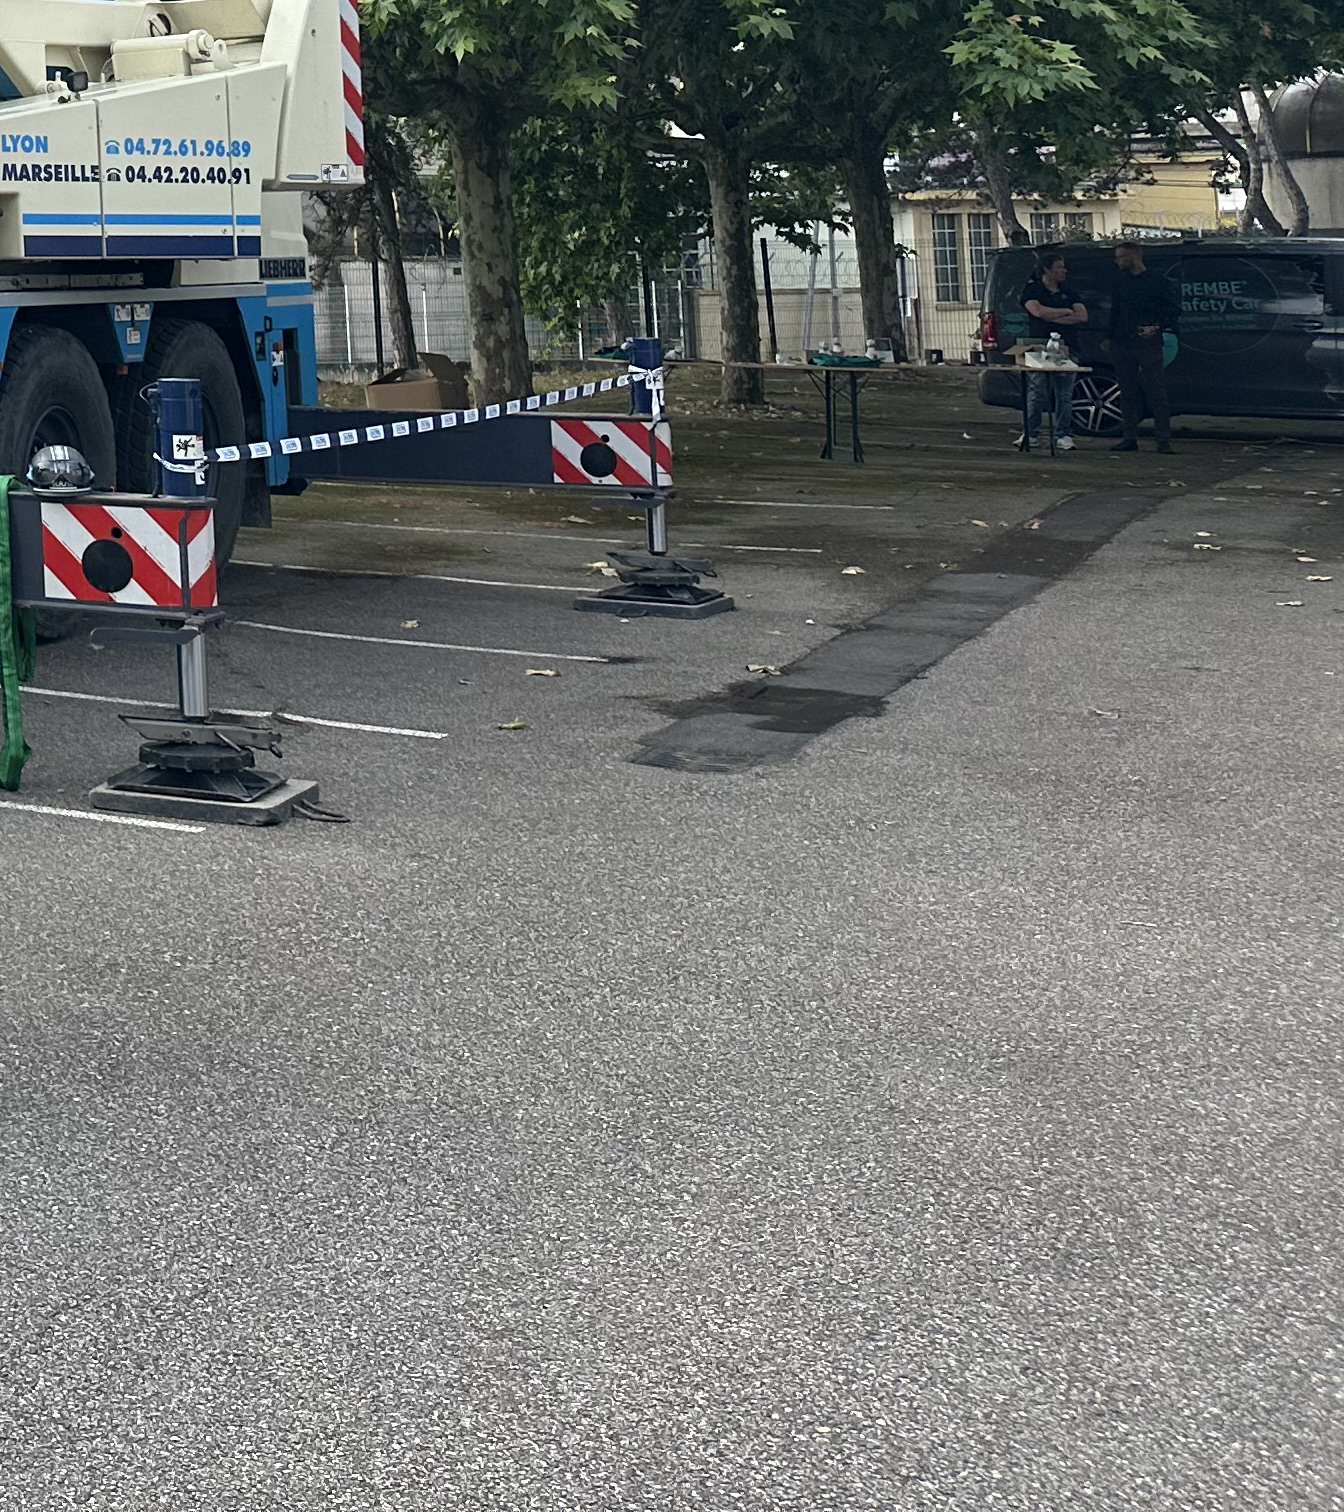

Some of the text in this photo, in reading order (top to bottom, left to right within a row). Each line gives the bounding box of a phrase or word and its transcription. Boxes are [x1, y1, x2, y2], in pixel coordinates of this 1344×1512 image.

[0, 135, 252, 158] LYON 04.72.61.96.89
[2, 163, 252, 185] MARSEILLE 04.42.20.40.91
[1182, 296, 1260, 313] afety Car
